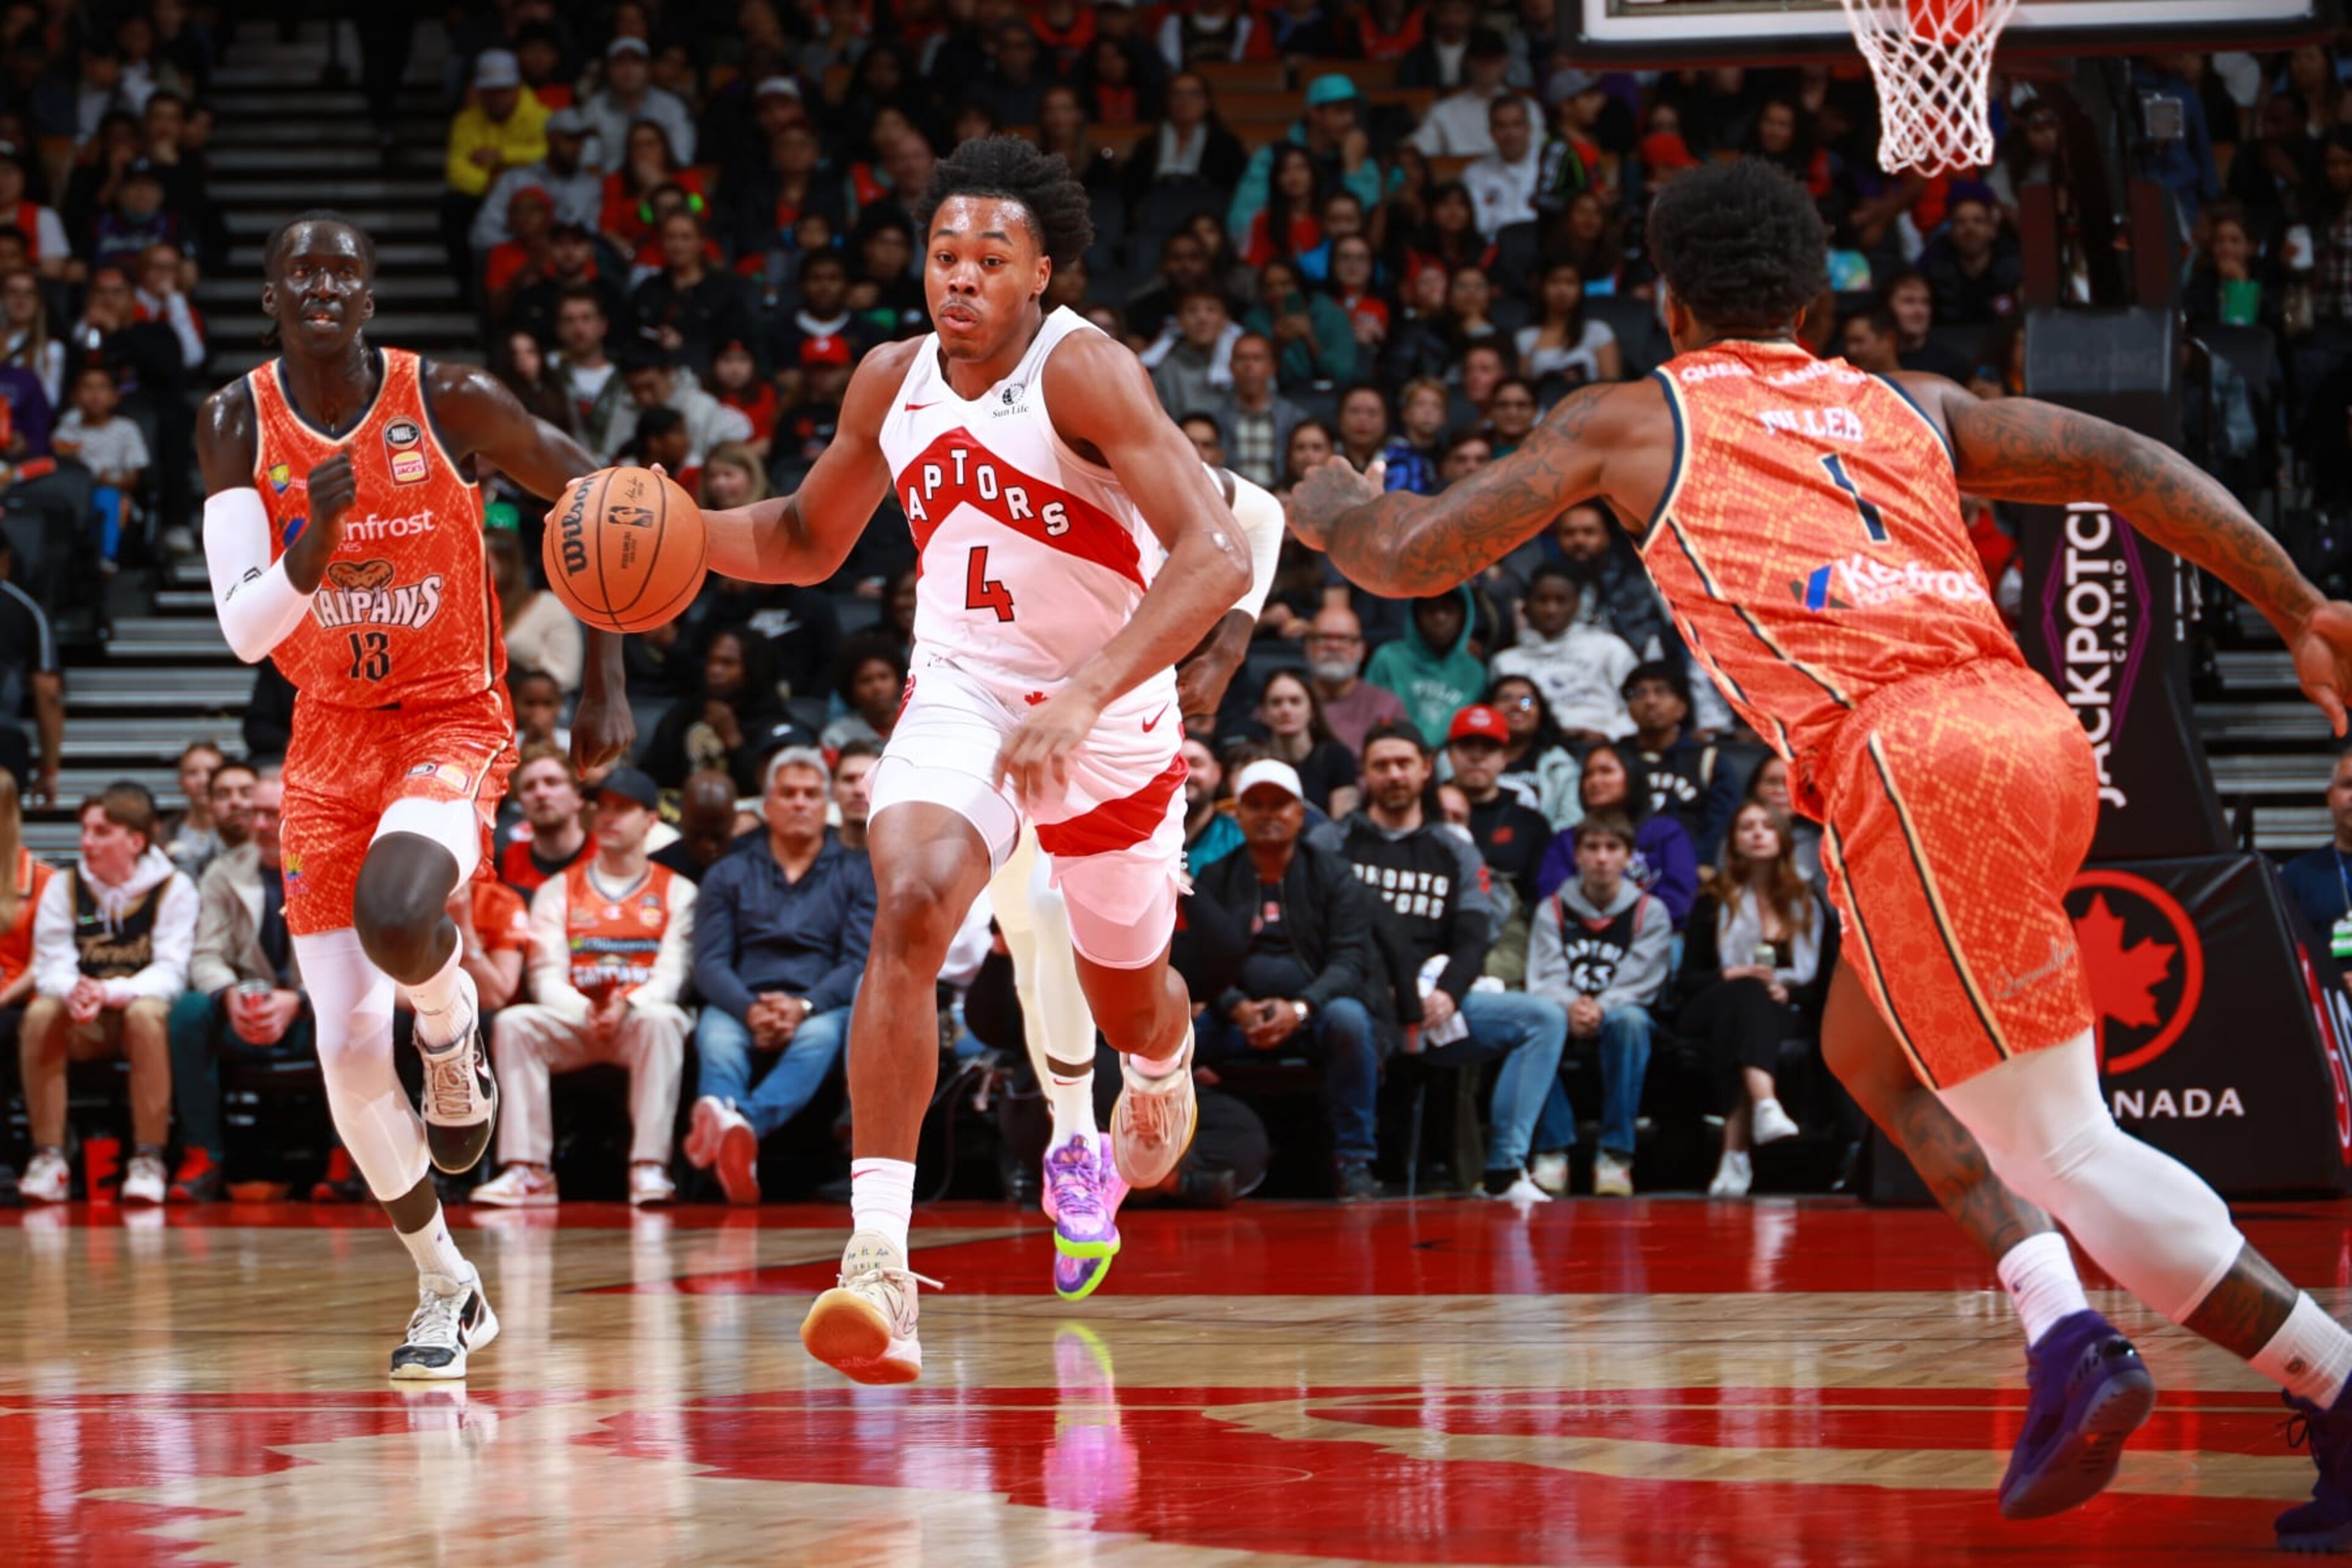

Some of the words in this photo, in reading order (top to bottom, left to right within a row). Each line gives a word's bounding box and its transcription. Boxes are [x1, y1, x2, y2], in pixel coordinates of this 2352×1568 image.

[992, 409, 1009, 418] Sun
[1012, 404, 1030, 415] Life
[908, 448, 1071, 537] APTORS
[1819, 453, 1892, 544] 1
[346, 509, 435, 540] nfrost
[561, 474, 600, 577] Wilson
[311, 574, 443, 630] AIPANS
[965, 545, 1016, 623] 4
[2112, 559, 2127, 663] CASINO
[347, 631, 391, 681] 13
[1351, 863, 1449, 897] RONTO
[2113, 1087, 2245, 1119] NADA
